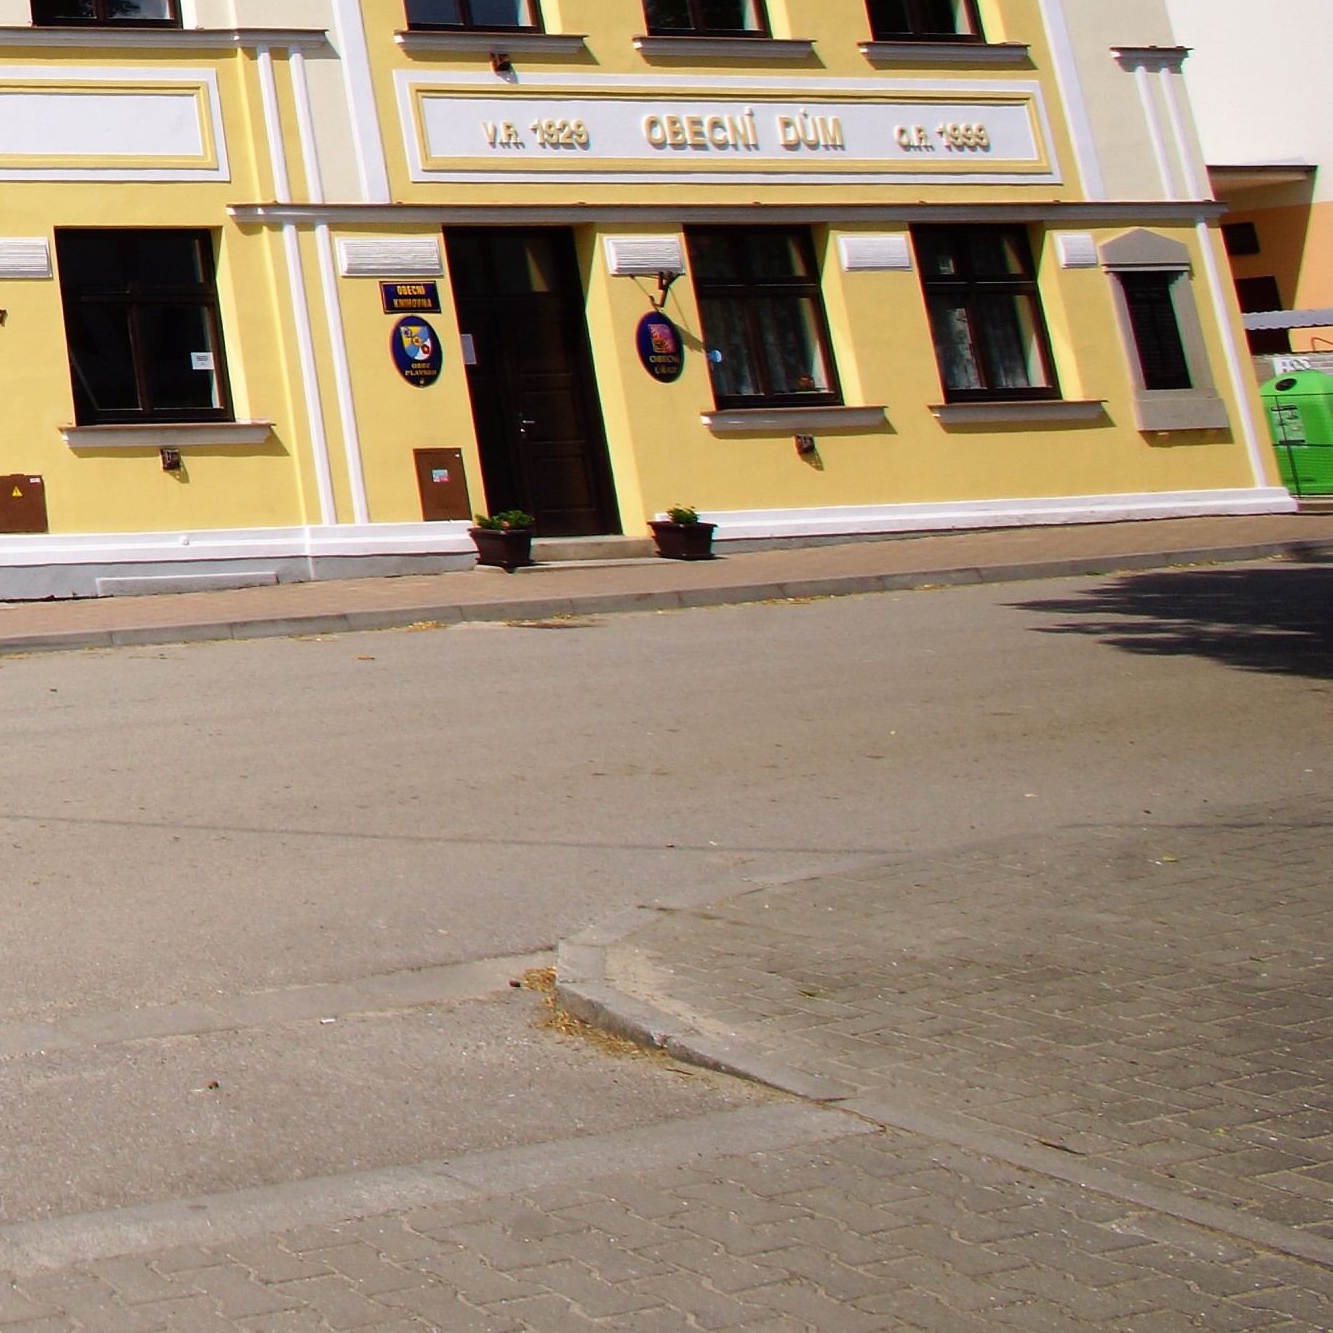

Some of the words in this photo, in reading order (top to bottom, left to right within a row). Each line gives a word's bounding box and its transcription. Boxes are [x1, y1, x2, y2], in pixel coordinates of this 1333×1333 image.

[529, 118, 590, 146] 1929
[643, 106, 758, 147] OBECNÍ
[777, 107, 845, 147] DŮM
